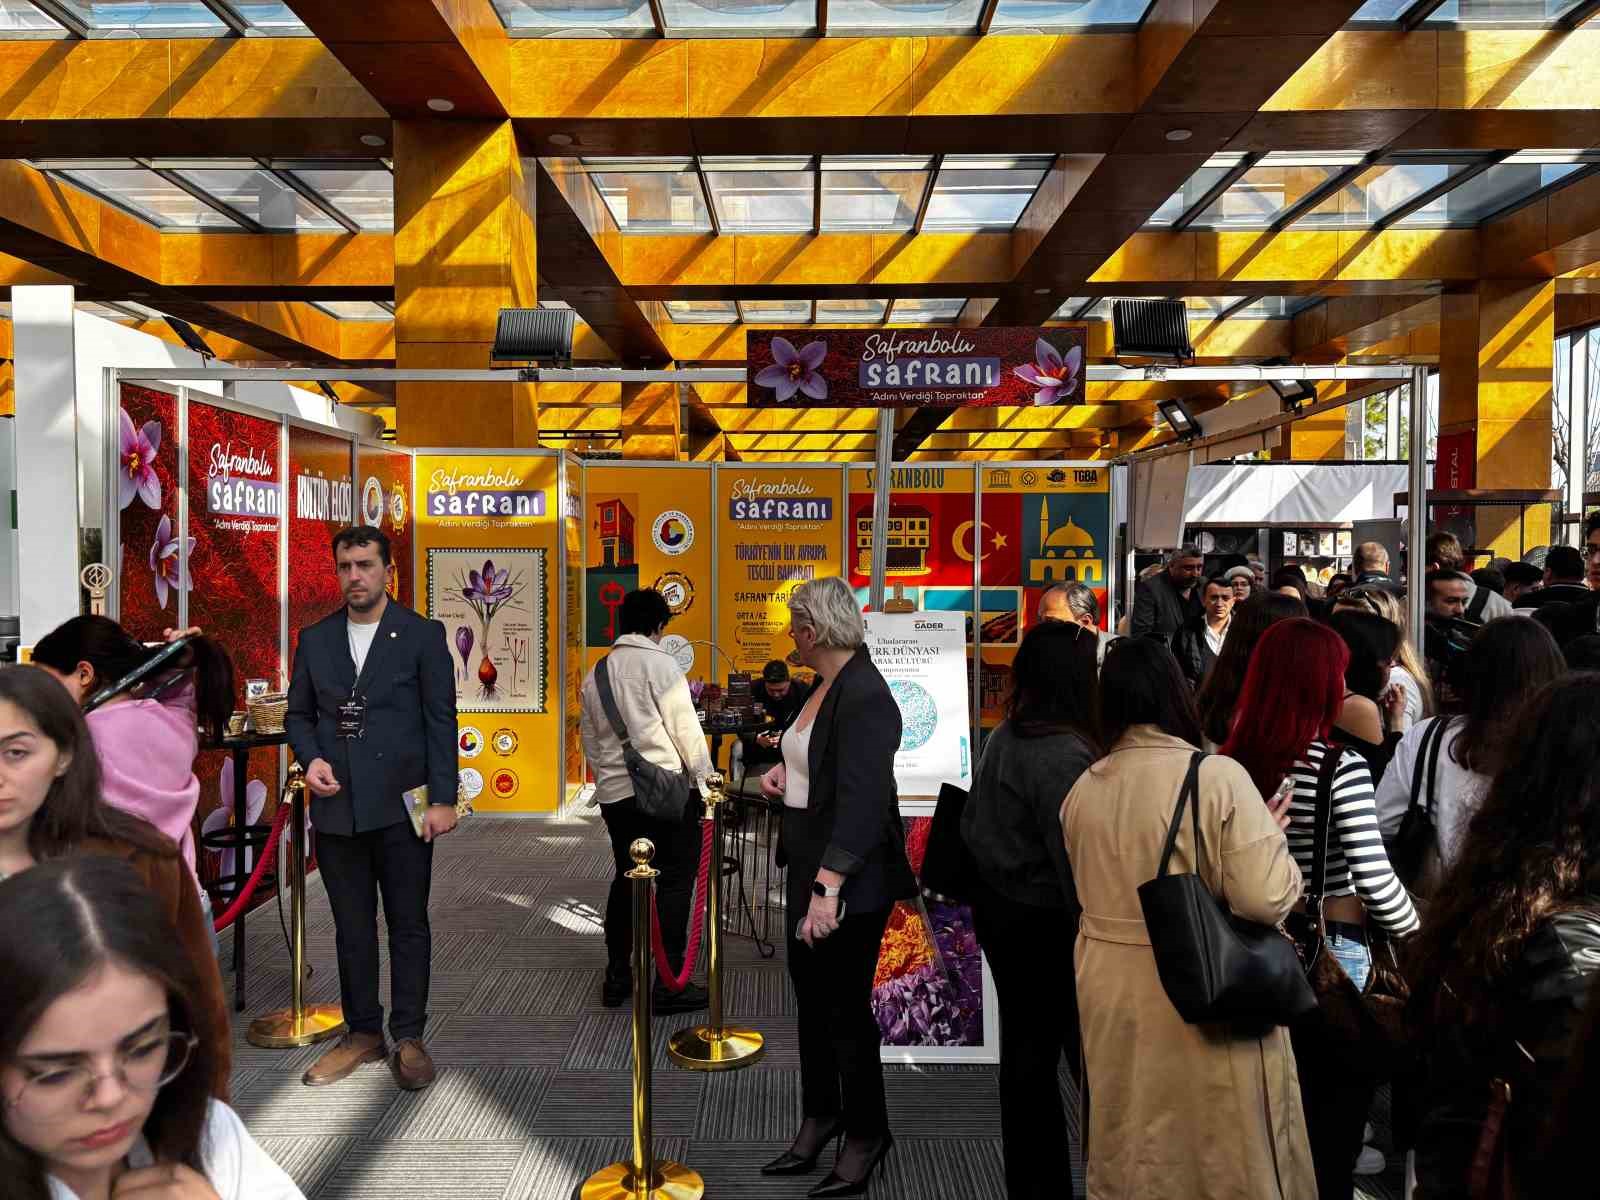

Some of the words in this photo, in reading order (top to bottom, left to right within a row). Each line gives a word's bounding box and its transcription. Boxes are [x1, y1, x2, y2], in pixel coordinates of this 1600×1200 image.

[862, 330, 975, 364] Safranbolu
[899, 391, 933, 403] Verdiği
[209, 442, 273, 483] Safranbolu
[428, 466, 524, 496] Safranbolu
[731, 475, 814, 502] Safranbolu
[866, 467, 945, 488] SRANBOLU
[297, 467, 330, 520] KÜLTÜR
[734, 591, 767, 602] SAFRAN
[869, 645, 890, 656] ÜRK
[892, 645, 941, 656] DÜNYASI
